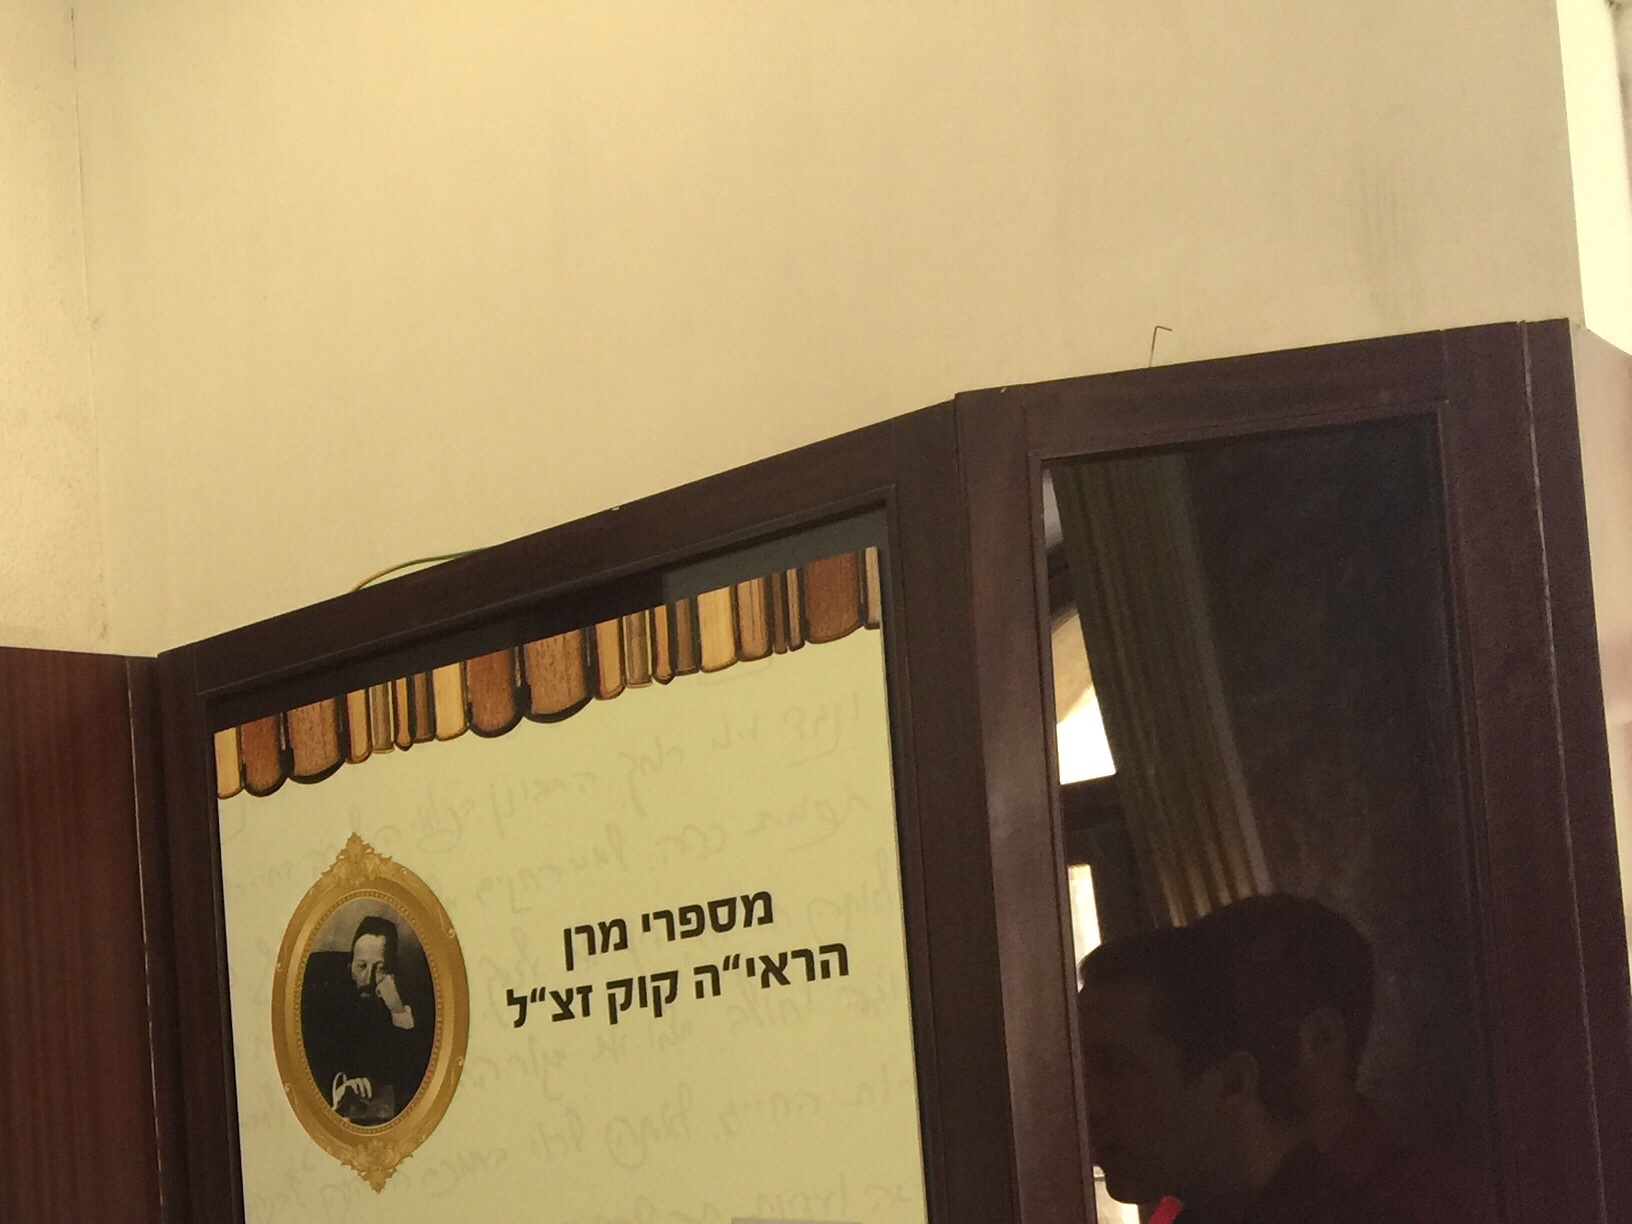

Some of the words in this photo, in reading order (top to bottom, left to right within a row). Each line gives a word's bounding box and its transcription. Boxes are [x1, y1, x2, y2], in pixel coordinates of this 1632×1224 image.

[641, 890, 774, 942] מספרי
[563, 917, 629, 972] מרן
[605, 970, 679, 1026] קוק
